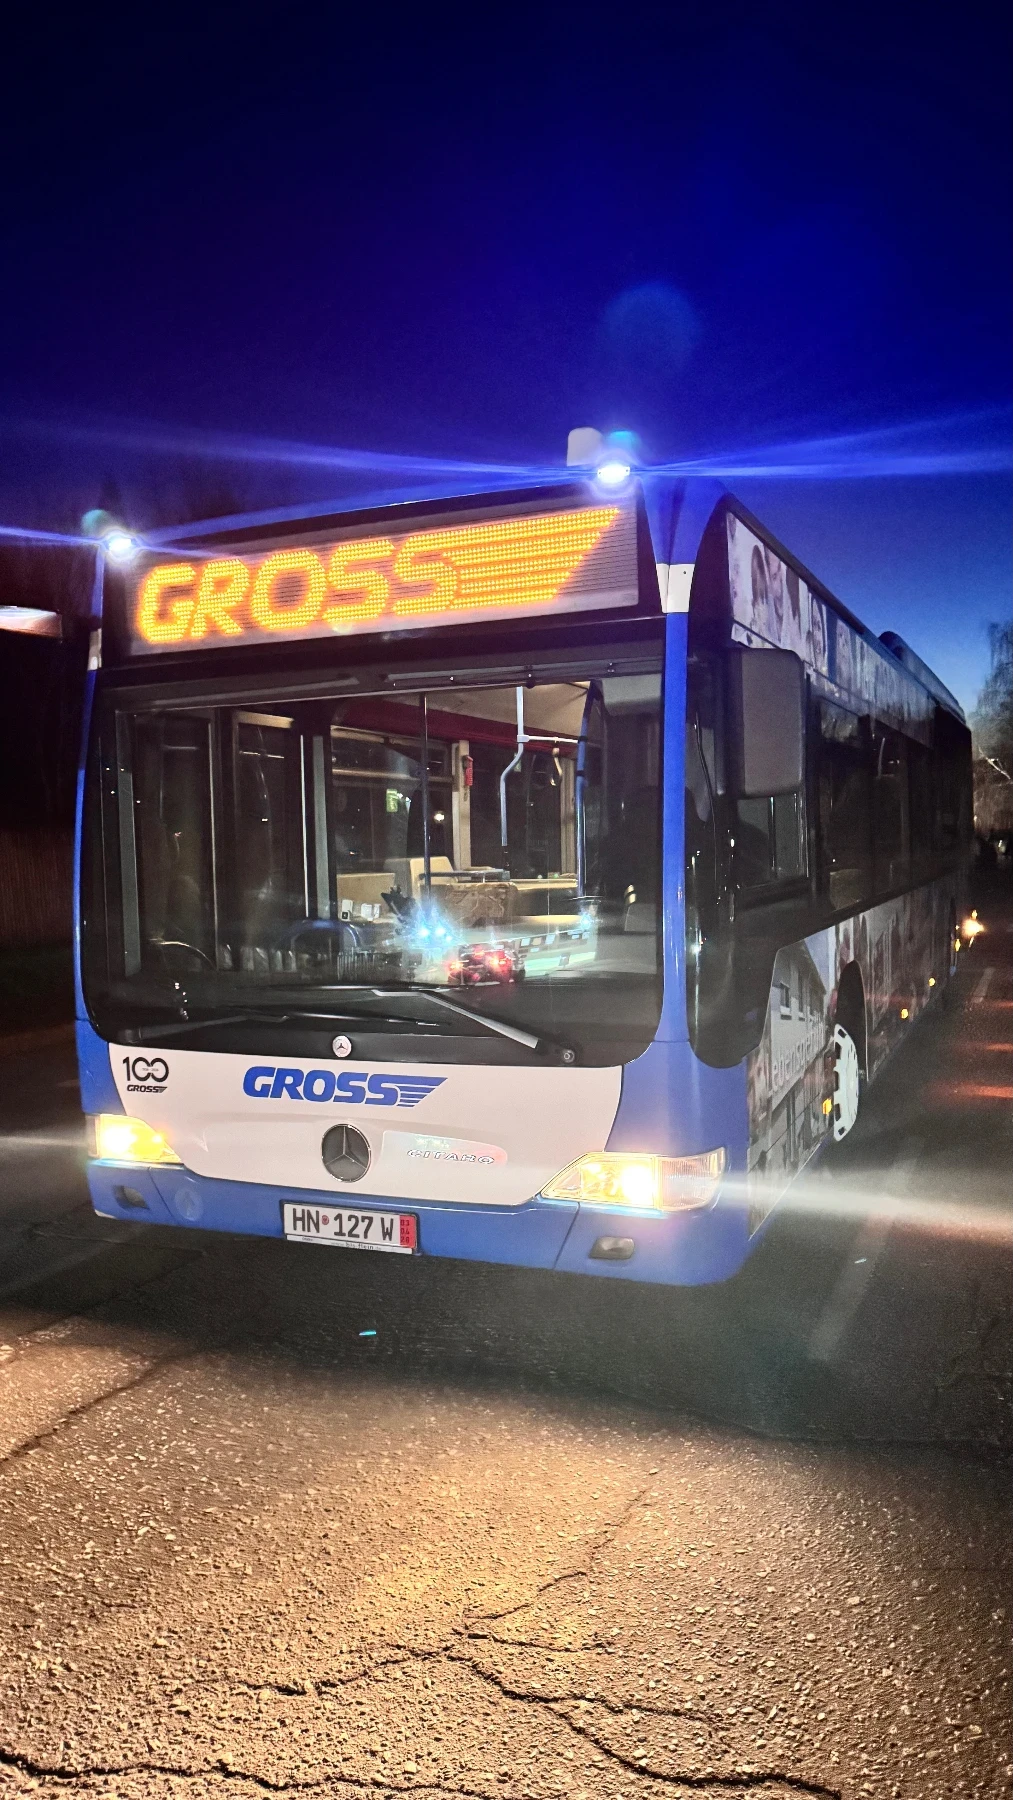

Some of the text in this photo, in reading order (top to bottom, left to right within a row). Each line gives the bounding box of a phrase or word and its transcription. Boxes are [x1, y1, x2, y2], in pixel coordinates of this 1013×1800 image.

[140, 515, 560, 643] GROSS
[122, 1056, 169, 1083] 100
[126, 1084, 167, 1094] GROSS
[243, 1066, 446, 1107] GROSS
[407, 1149, 495, 1165] CITARO
[292, 1208, 394, 1242] HN 127 W
